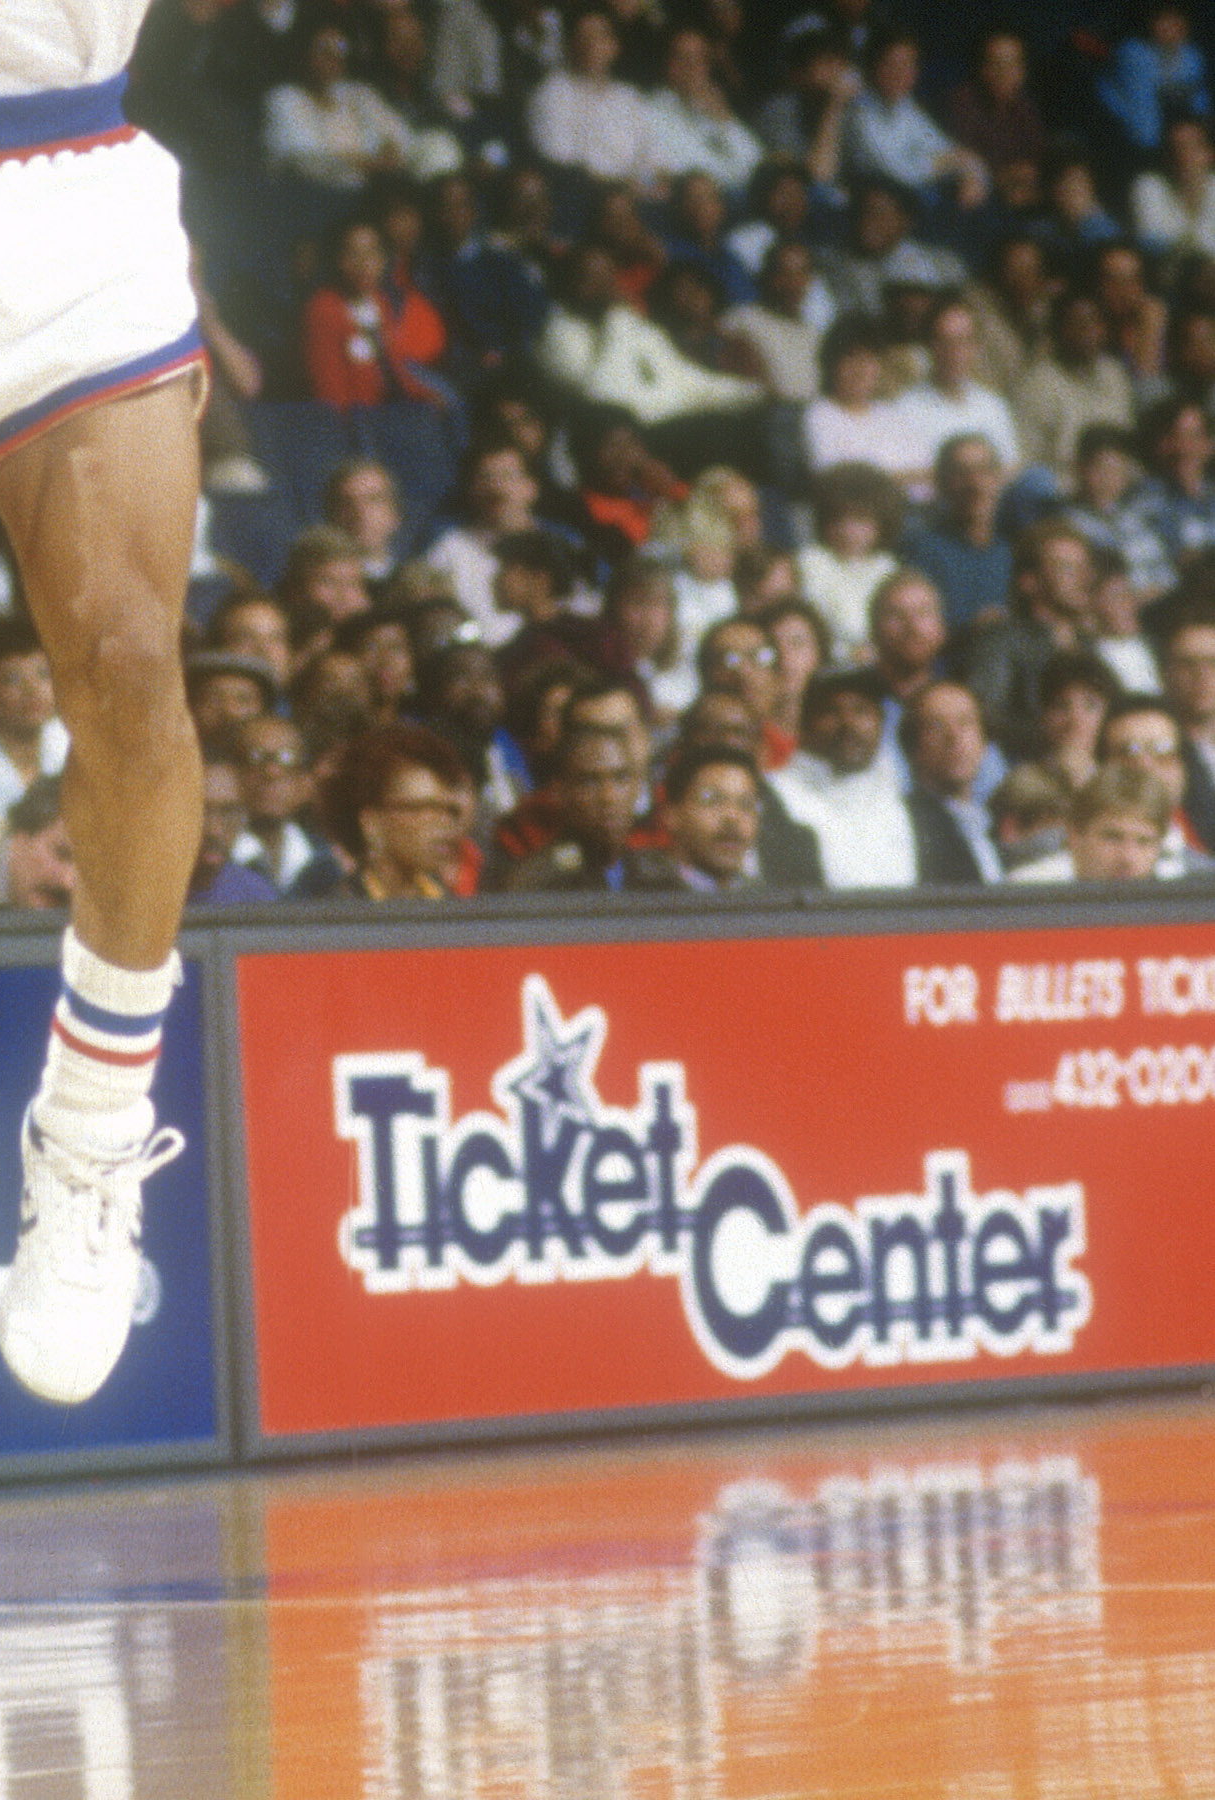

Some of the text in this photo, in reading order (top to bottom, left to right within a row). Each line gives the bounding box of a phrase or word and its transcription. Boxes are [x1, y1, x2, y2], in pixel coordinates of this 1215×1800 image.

[902, 963, 979, 1026] FOR
[994, 956, 1126, 1022] BULLETS
[1052, 1044, 1215, 1109] 432-020
